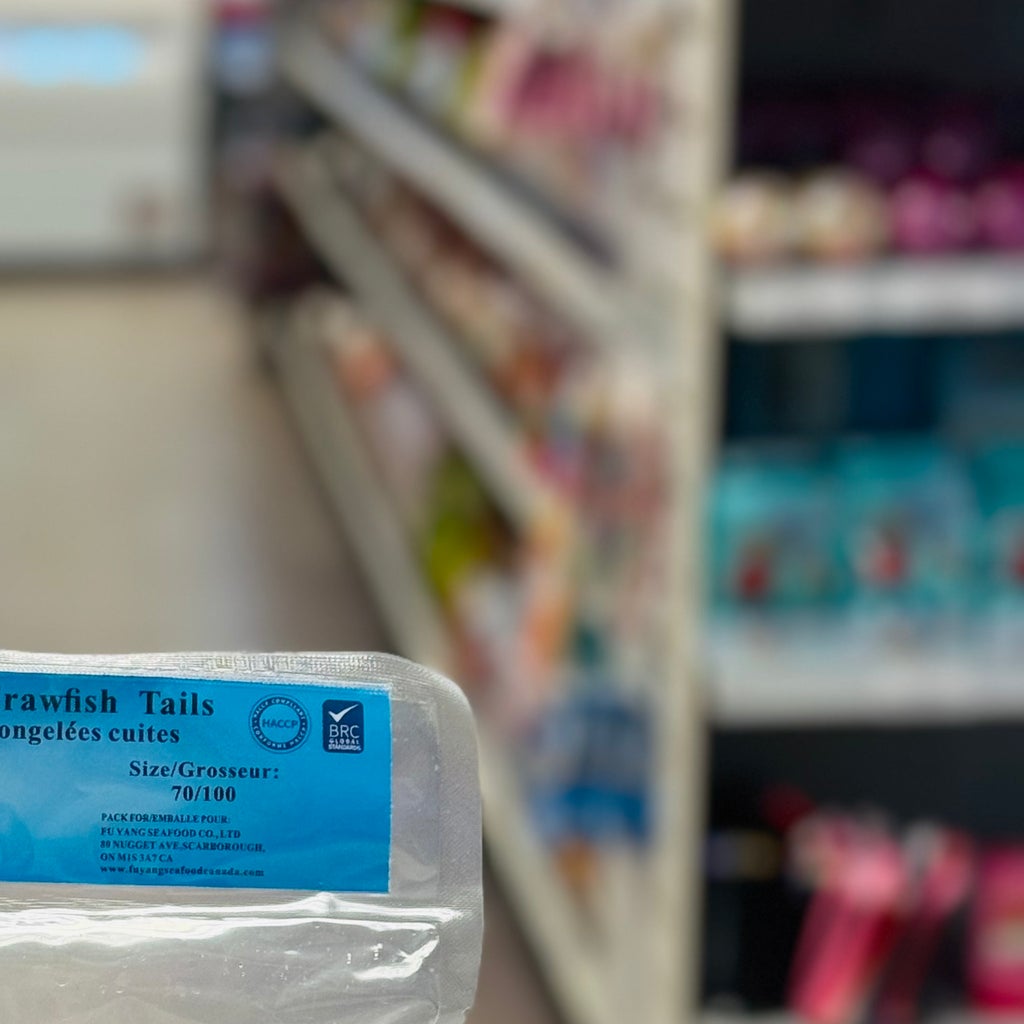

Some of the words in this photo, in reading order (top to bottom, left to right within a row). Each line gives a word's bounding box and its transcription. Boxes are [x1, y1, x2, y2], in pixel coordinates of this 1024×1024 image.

[139, 690, 215, 717] Tails
[262, 719, 298, 729] HACCP
[108, 725, 180, 743] cuites
[329, 724, 360, 739] BRC
[129, 760, 279, 779] Size/Grosseur:
[172, 785, 236, 802] 70/100
[101, 812, 128, 822] PACK
[101, 827, 114, 836] FU
[116, 828, 146, 837] YANG
[147, 829, 197, 838] SEAFOOD
[113, 840, 157, 850] NUGGET
[100, 852, 115, 861] ON
[158, 854, 173, 863] CA
